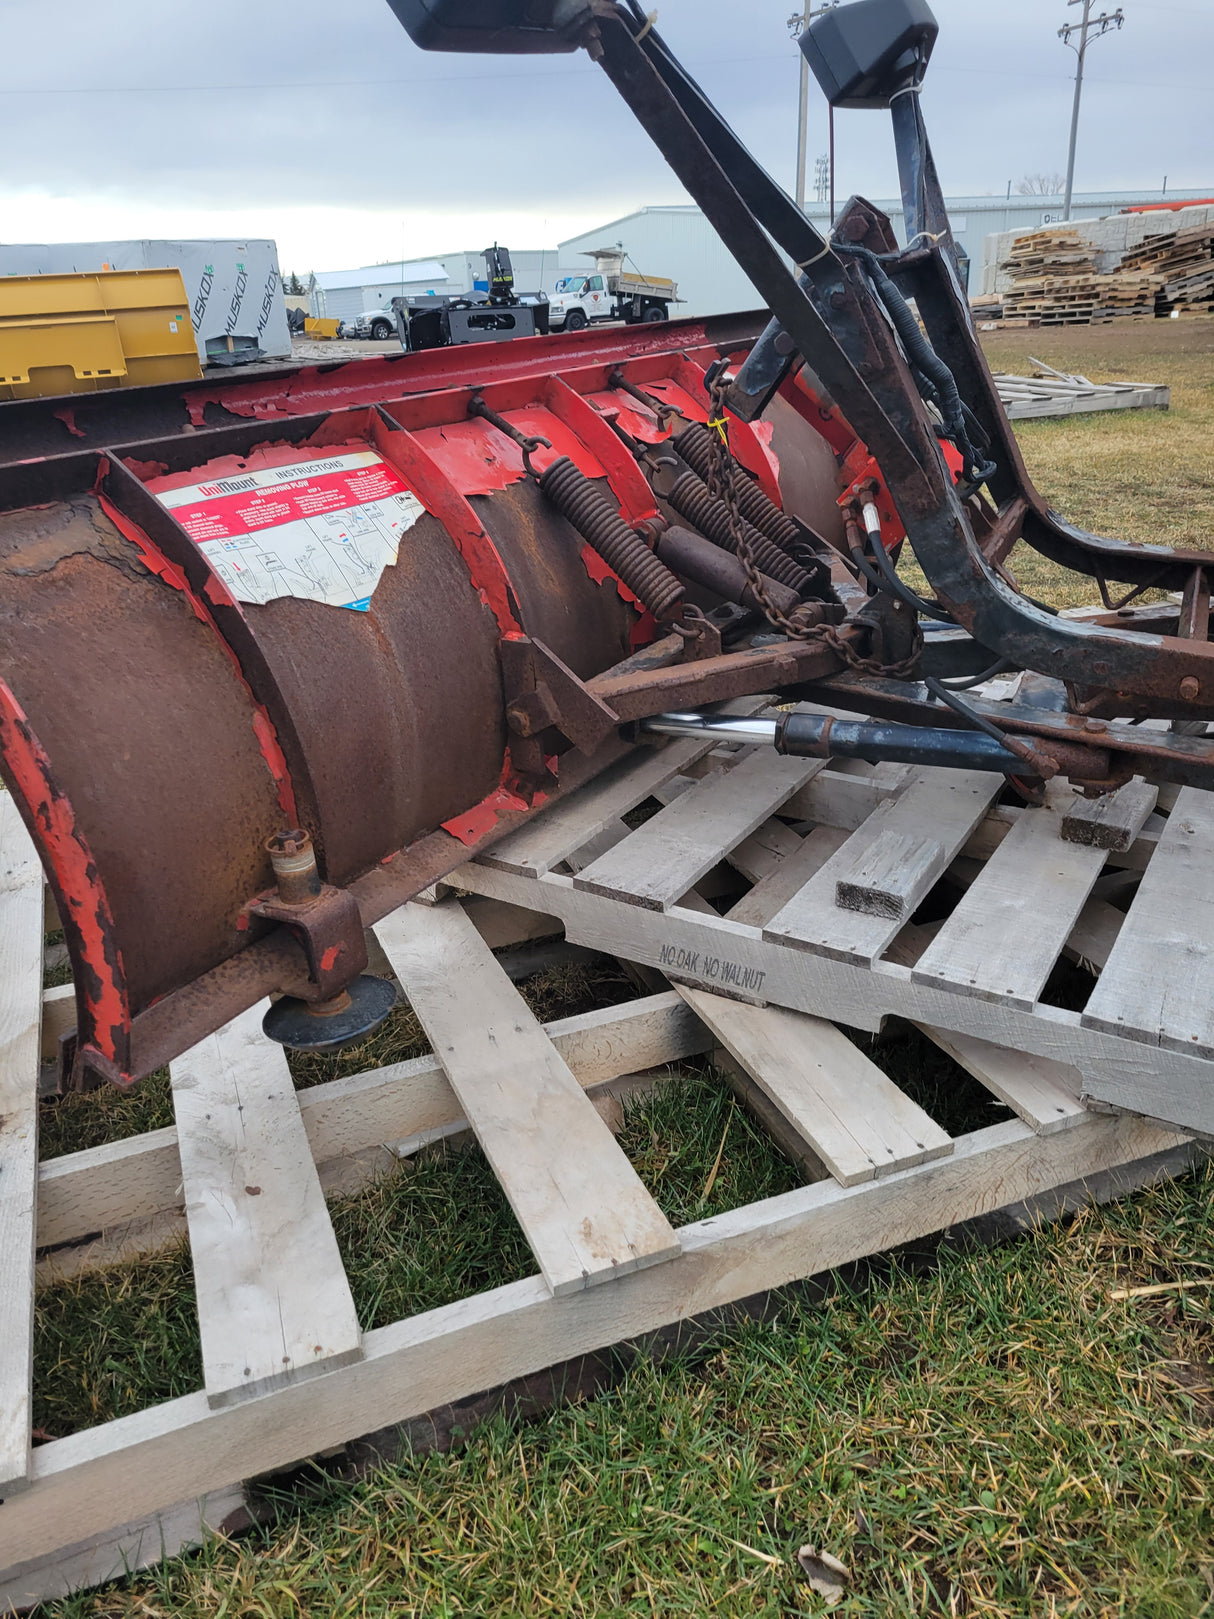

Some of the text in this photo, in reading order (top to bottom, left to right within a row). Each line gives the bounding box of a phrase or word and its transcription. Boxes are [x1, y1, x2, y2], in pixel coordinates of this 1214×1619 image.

[224, 270, 248, 336] MUSKOX
[256, 264, 279, 337] MUSKOX
[197, 460, 343, 498] UniMount INSTRUCTIONS
[256, 480, 309, 497] REMOVING PLOW
[659, 944, 767, 992] NO OAK NO WALNUT
